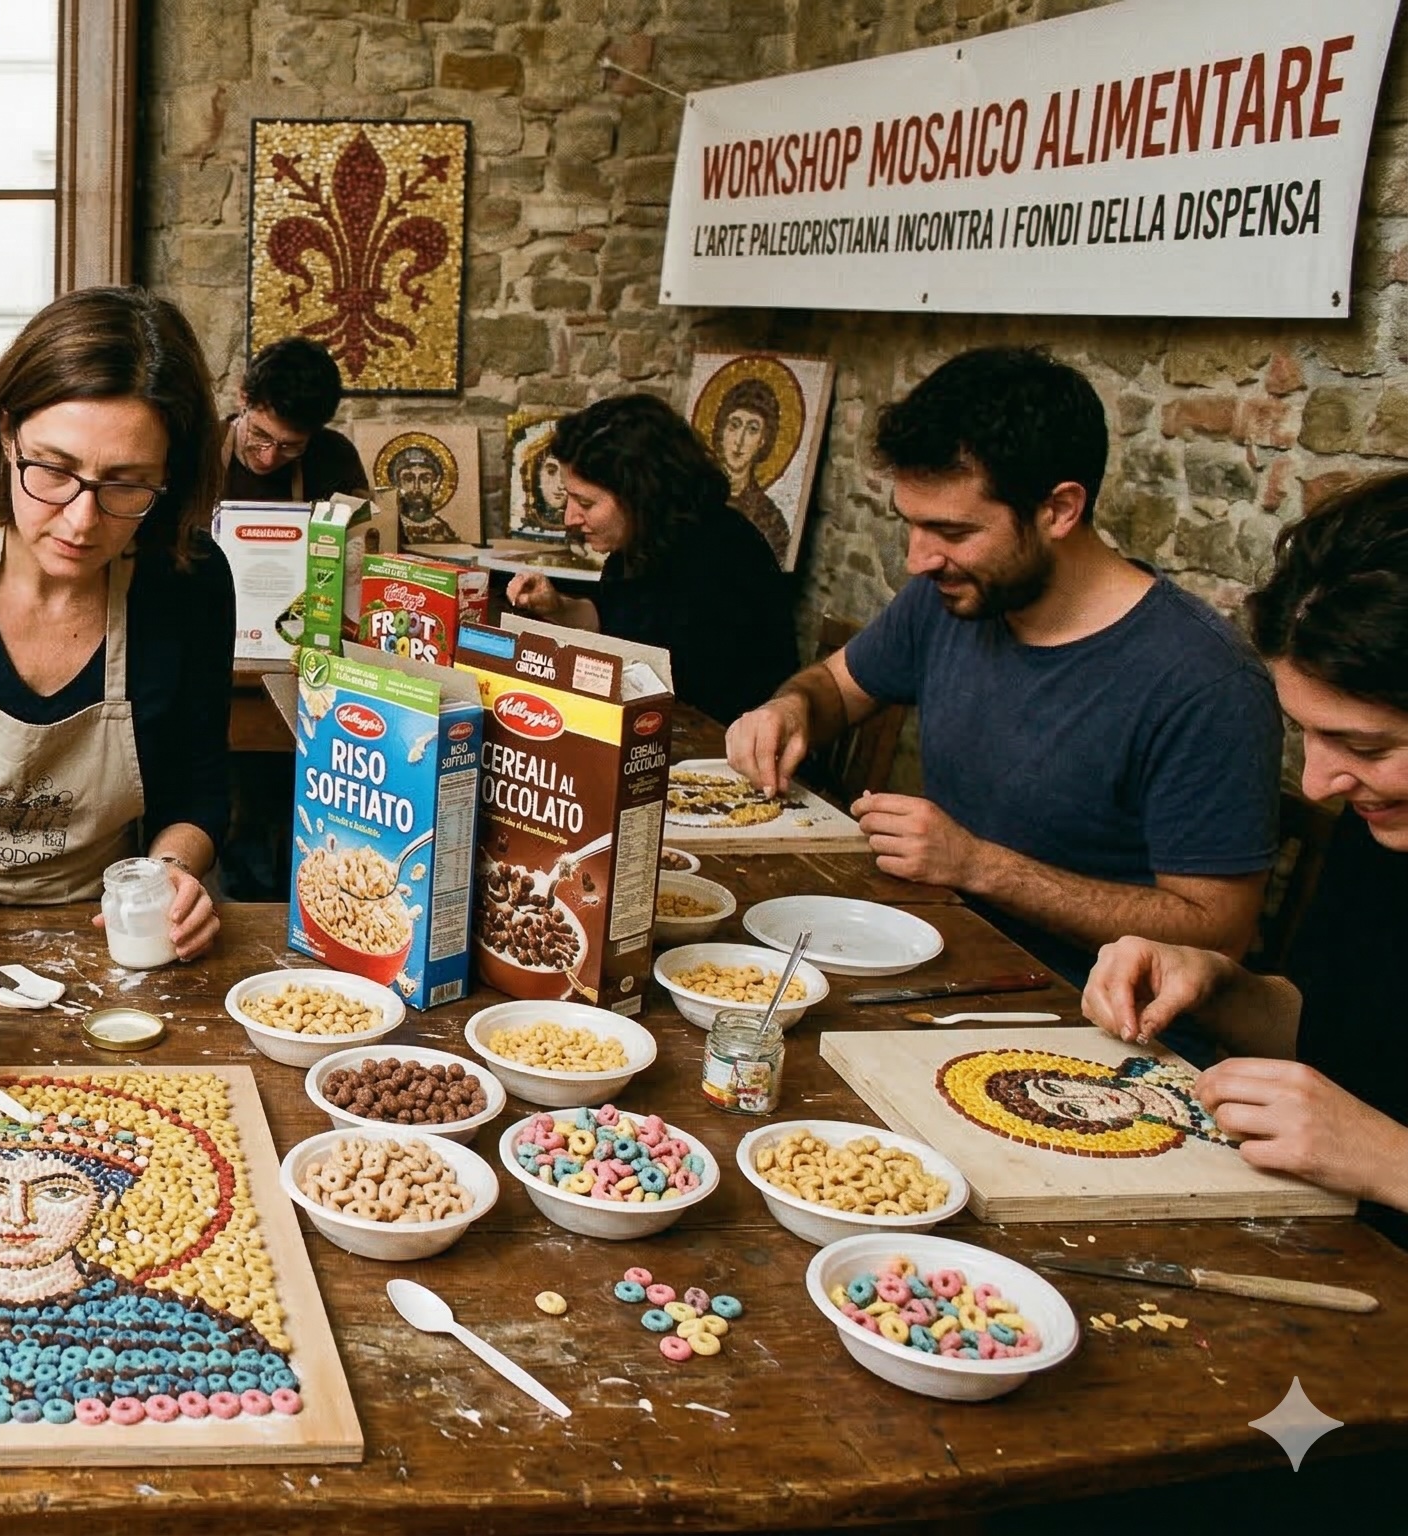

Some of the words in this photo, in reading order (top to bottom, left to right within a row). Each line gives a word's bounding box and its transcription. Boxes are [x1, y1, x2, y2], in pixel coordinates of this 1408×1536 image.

[703, 126, 862, 200] WORKSHOP
[868, 98, 1028, 188] MOSAICO
[1034, 34, 1355, 170] ALIMENTARE
[694, 223, 748, 257] L'ARTE
[749, 215, 890, 256] PALEOCRISTIANA
[895, 208, 994, 253] INCONTRA
[999, 207, 1010, 249] I
[1012, 201, 1083, 248] FONDI
[1087, 194, 1166, 245] DELLA
[1174, 179, 1321, 241] DISPENSA
[371, 610, 436, 641] FROOT
[332, 737, 386, 785] RISO
[480, 741, 557, 790] CEREALI
[559, 774, 577, 798] AL
[305, 767, 414, 833] SOFFIATO
[482, 775, 584, 833] OCCOLATO
